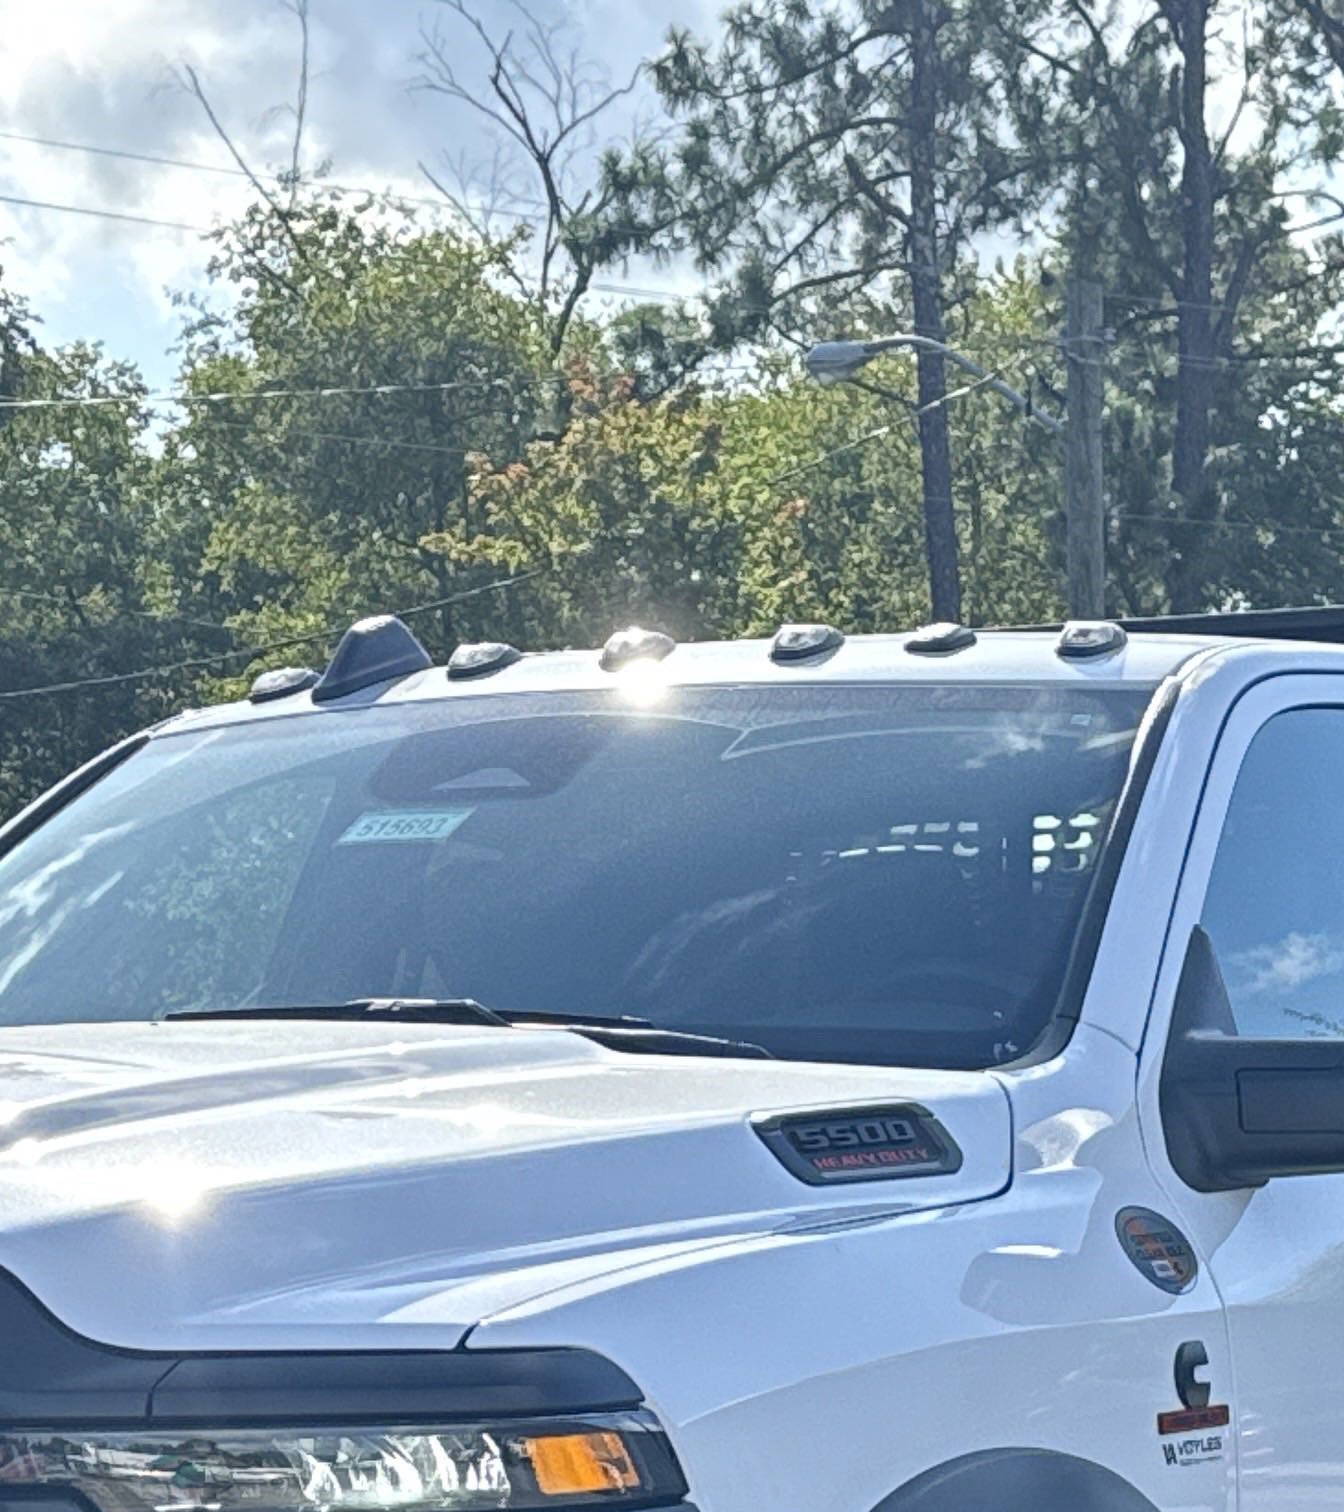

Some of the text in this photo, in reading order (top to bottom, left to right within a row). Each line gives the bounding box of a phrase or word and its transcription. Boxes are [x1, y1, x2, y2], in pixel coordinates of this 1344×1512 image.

[797, 1119, 917, 1149] 5500
[812, 1148, 929, 1169] HEAVY DUTY
